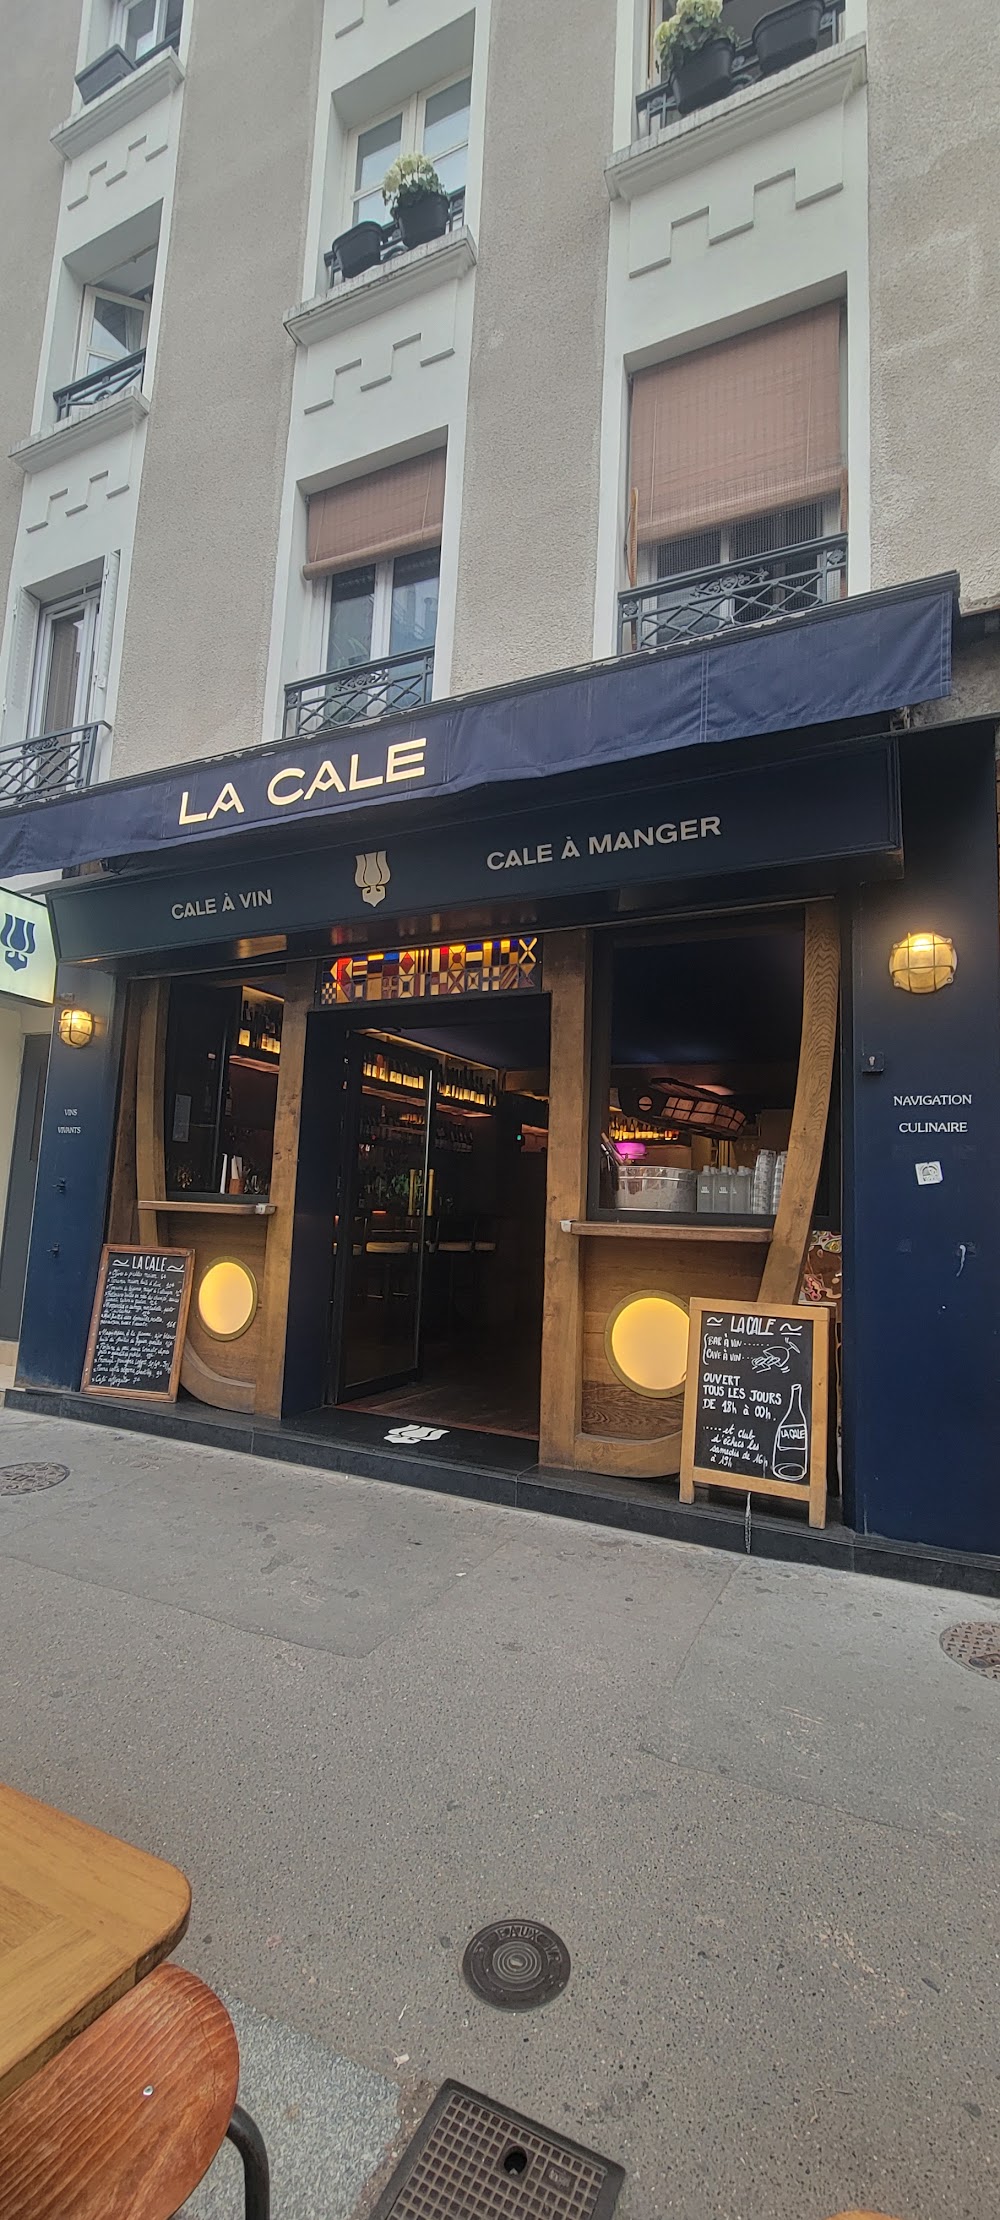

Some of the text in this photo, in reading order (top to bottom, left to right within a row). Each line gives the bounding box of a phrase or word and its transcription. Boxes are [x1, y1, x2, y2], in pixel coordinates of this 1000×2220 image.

[178, 737, 427, 825] LA CALE
[486, 815, 722, 870] CALE À MANGER
[171, 888, 273, 920] CALE À VIN
[893, 1094, 972, 1106] NAVIGATION
[64, 1108, 78, 1116] VINS
[898, 1122, 968, 1133] CULINAIRE
[132, 1255, 167, 1272] LA CALE
[730, 1315, 776, 1336] LA CALE
[724, 1333, 729, 1347] À
[706, 1348, 722, 1360] CAVE
[723, 1349, 728, 1361] À
[703, 1373, 740, 1386] OUVERT
[703, 1384, 782, 1405] TOUS LES JOURS
[702, 1398, 716, 1410] DE
[721, 1400, 737, 1414] 18h
[743, 1405, 750, 1416] à
[780, 1429, 805, 1440] LA CALE
[710, 1444, 739, 1458] samedis
[742, 1451, 750, 1460] de
[747, 1440, 759, 1451] les
[710, 1454, 716, 1463] à
[495, 1925, 543, 1943] EAUX
